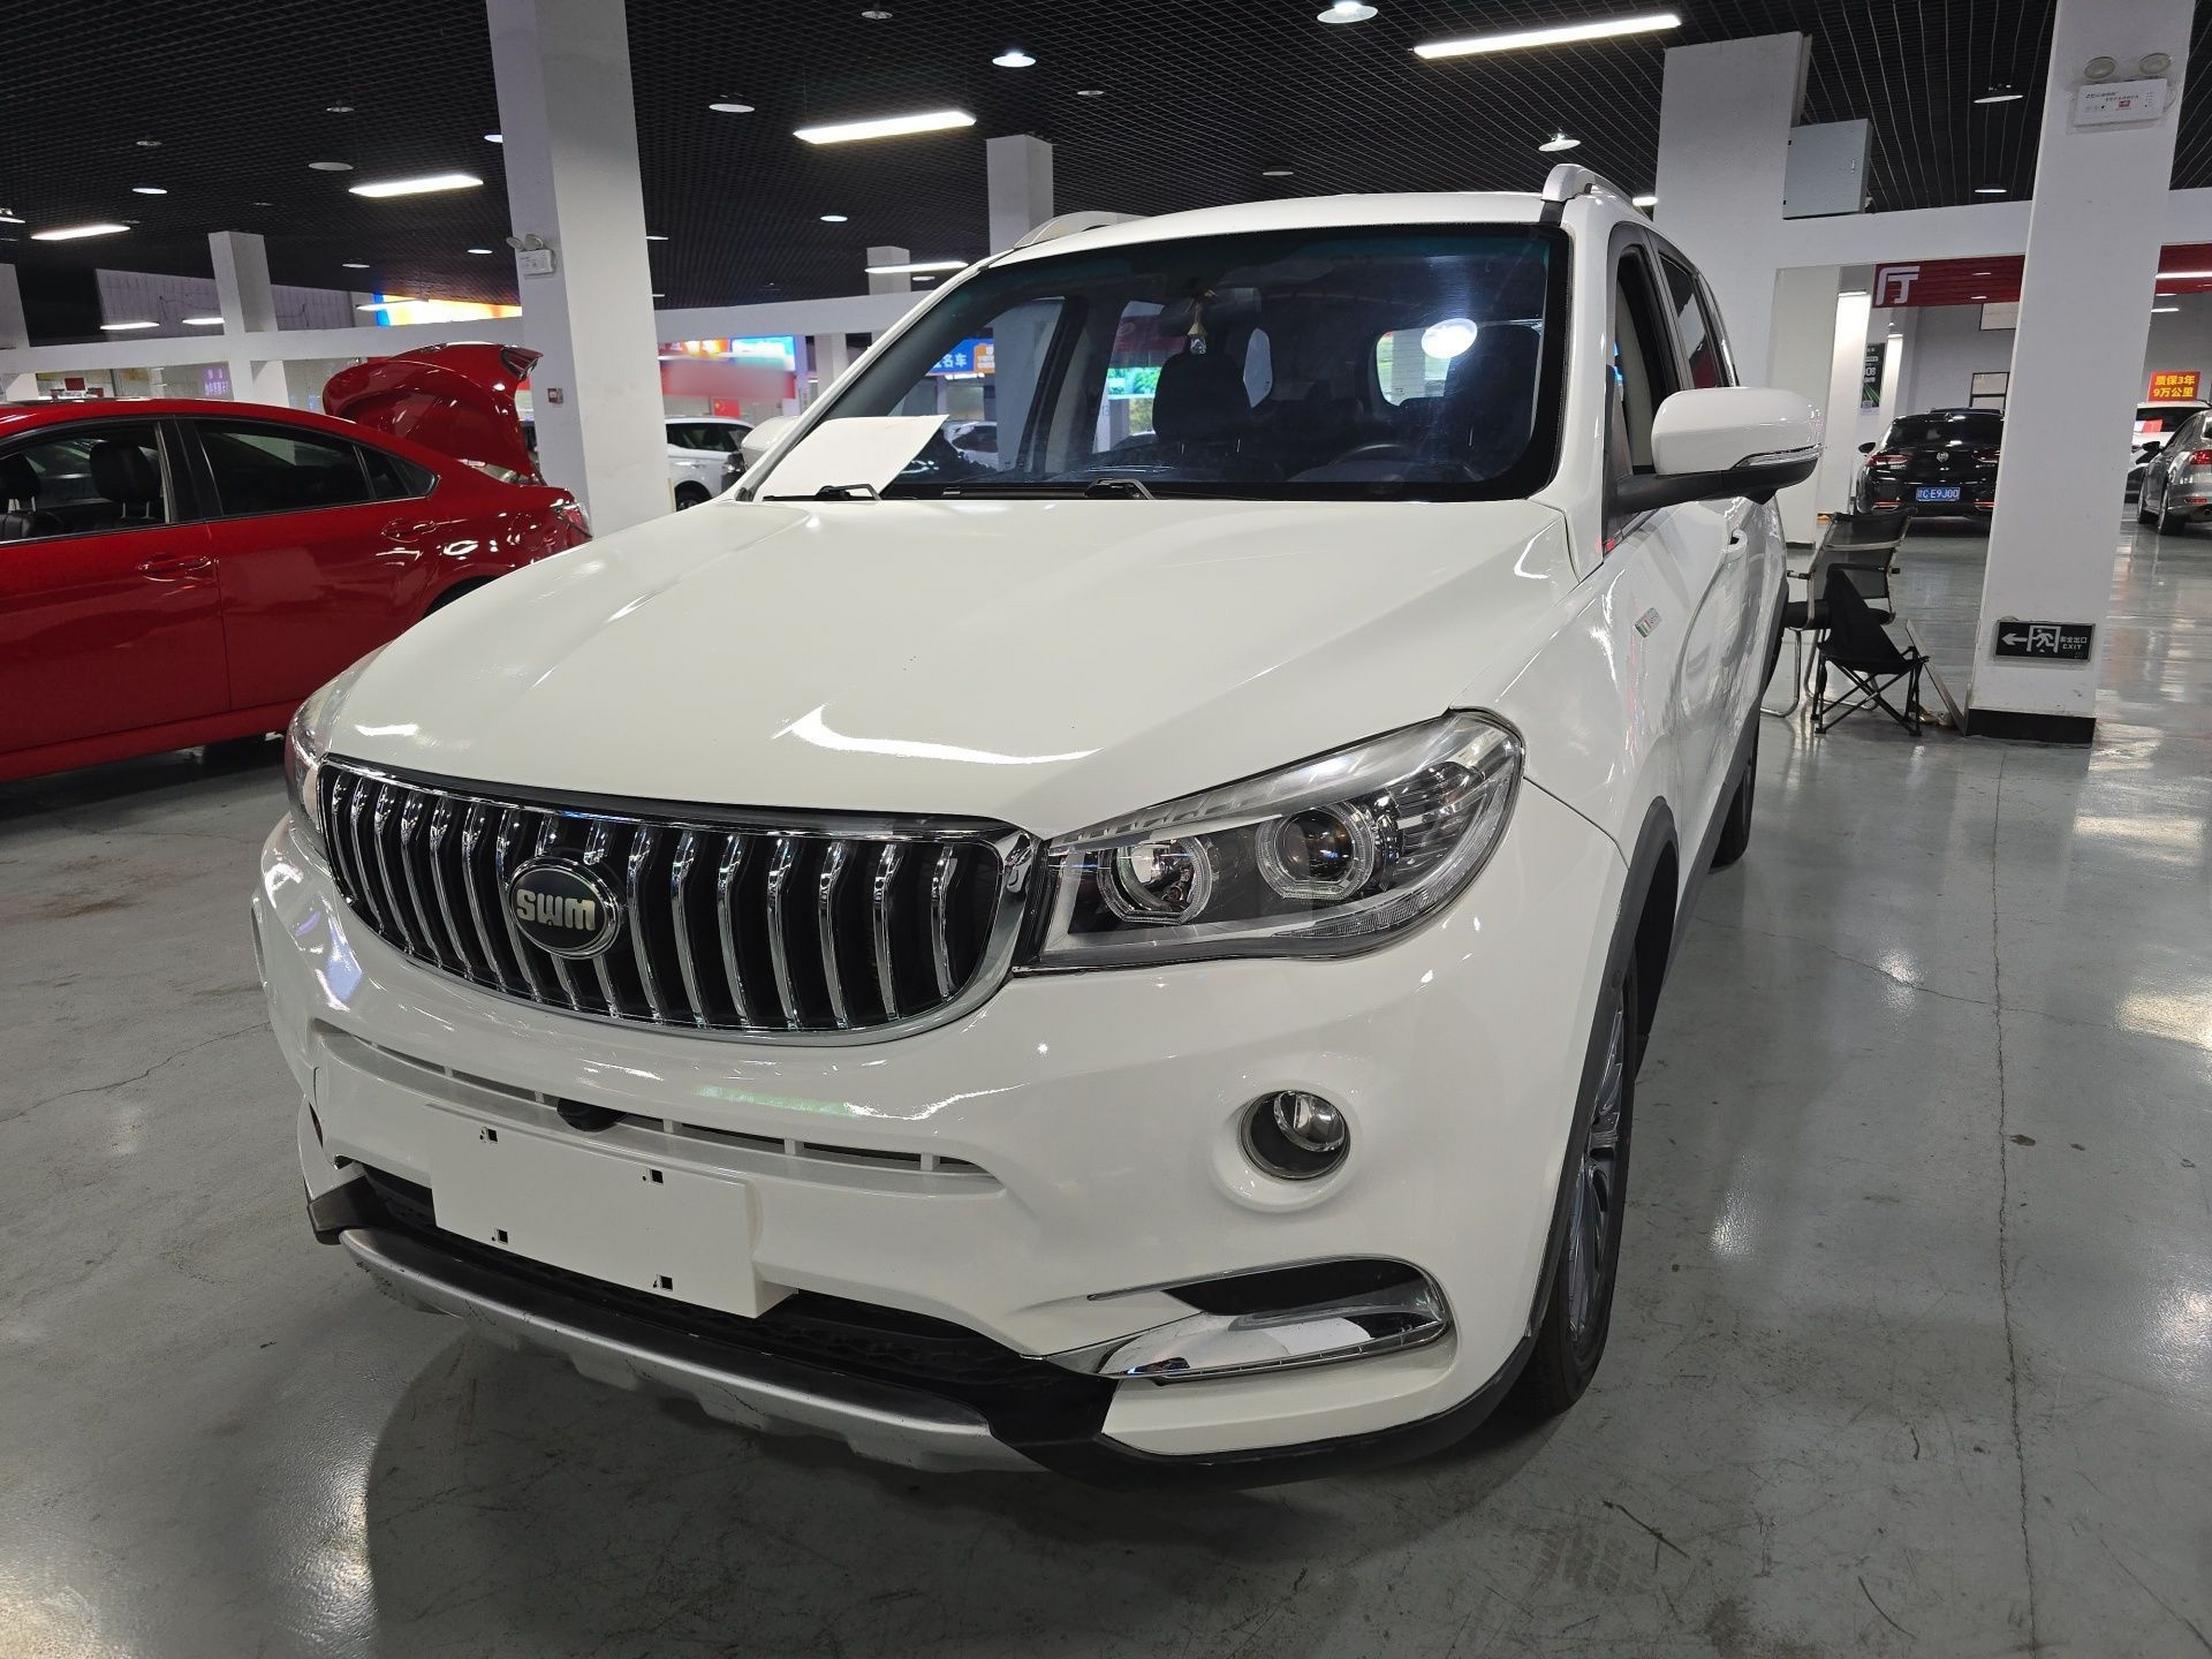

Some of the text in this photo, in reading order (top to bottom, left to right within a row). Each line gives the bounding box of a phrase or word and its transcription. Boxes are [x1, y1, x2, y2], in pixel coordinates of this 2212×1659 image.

[2155, 375, 2195, 385] 质保3年
[2153, 387, 2194, 397] 9万公里
[517, 889, 596, 931] SWM
